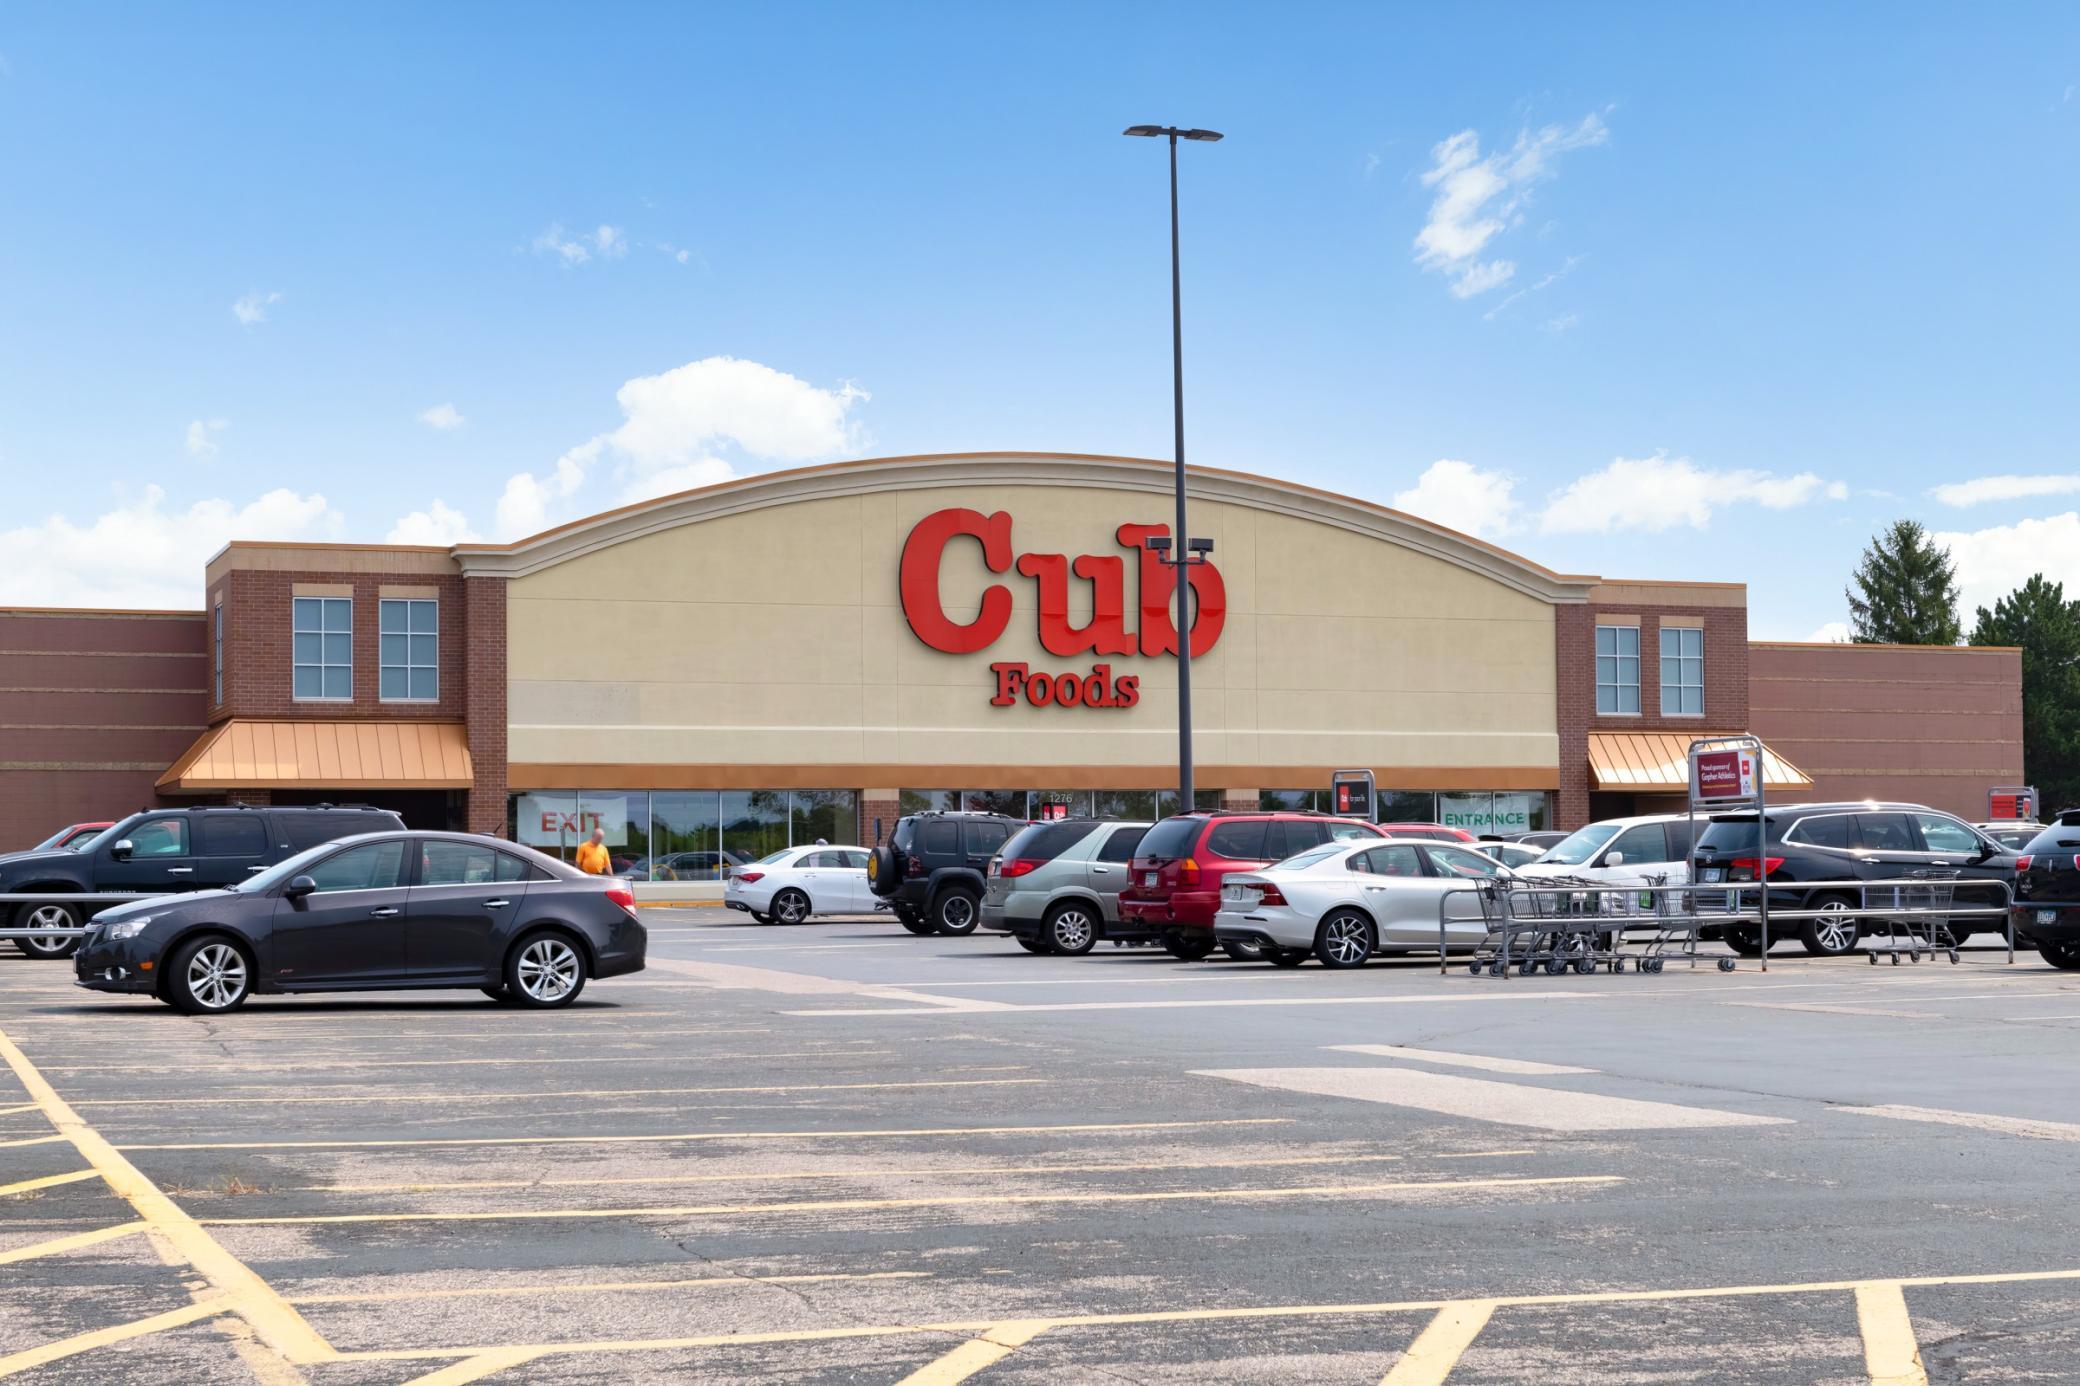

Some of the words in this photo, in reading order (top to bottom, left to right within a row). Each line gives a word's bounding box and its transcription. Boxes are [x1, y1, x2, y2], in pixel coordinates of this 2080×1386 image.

[899, 507, 1227, 657] Cub
[990, 661, 1140, 708] Foods
[1050, 793, 1073, 803] 1276
[541, 811, 605, 833] EXIT
[1445, 812, 1525, 826] ENTRANCE
